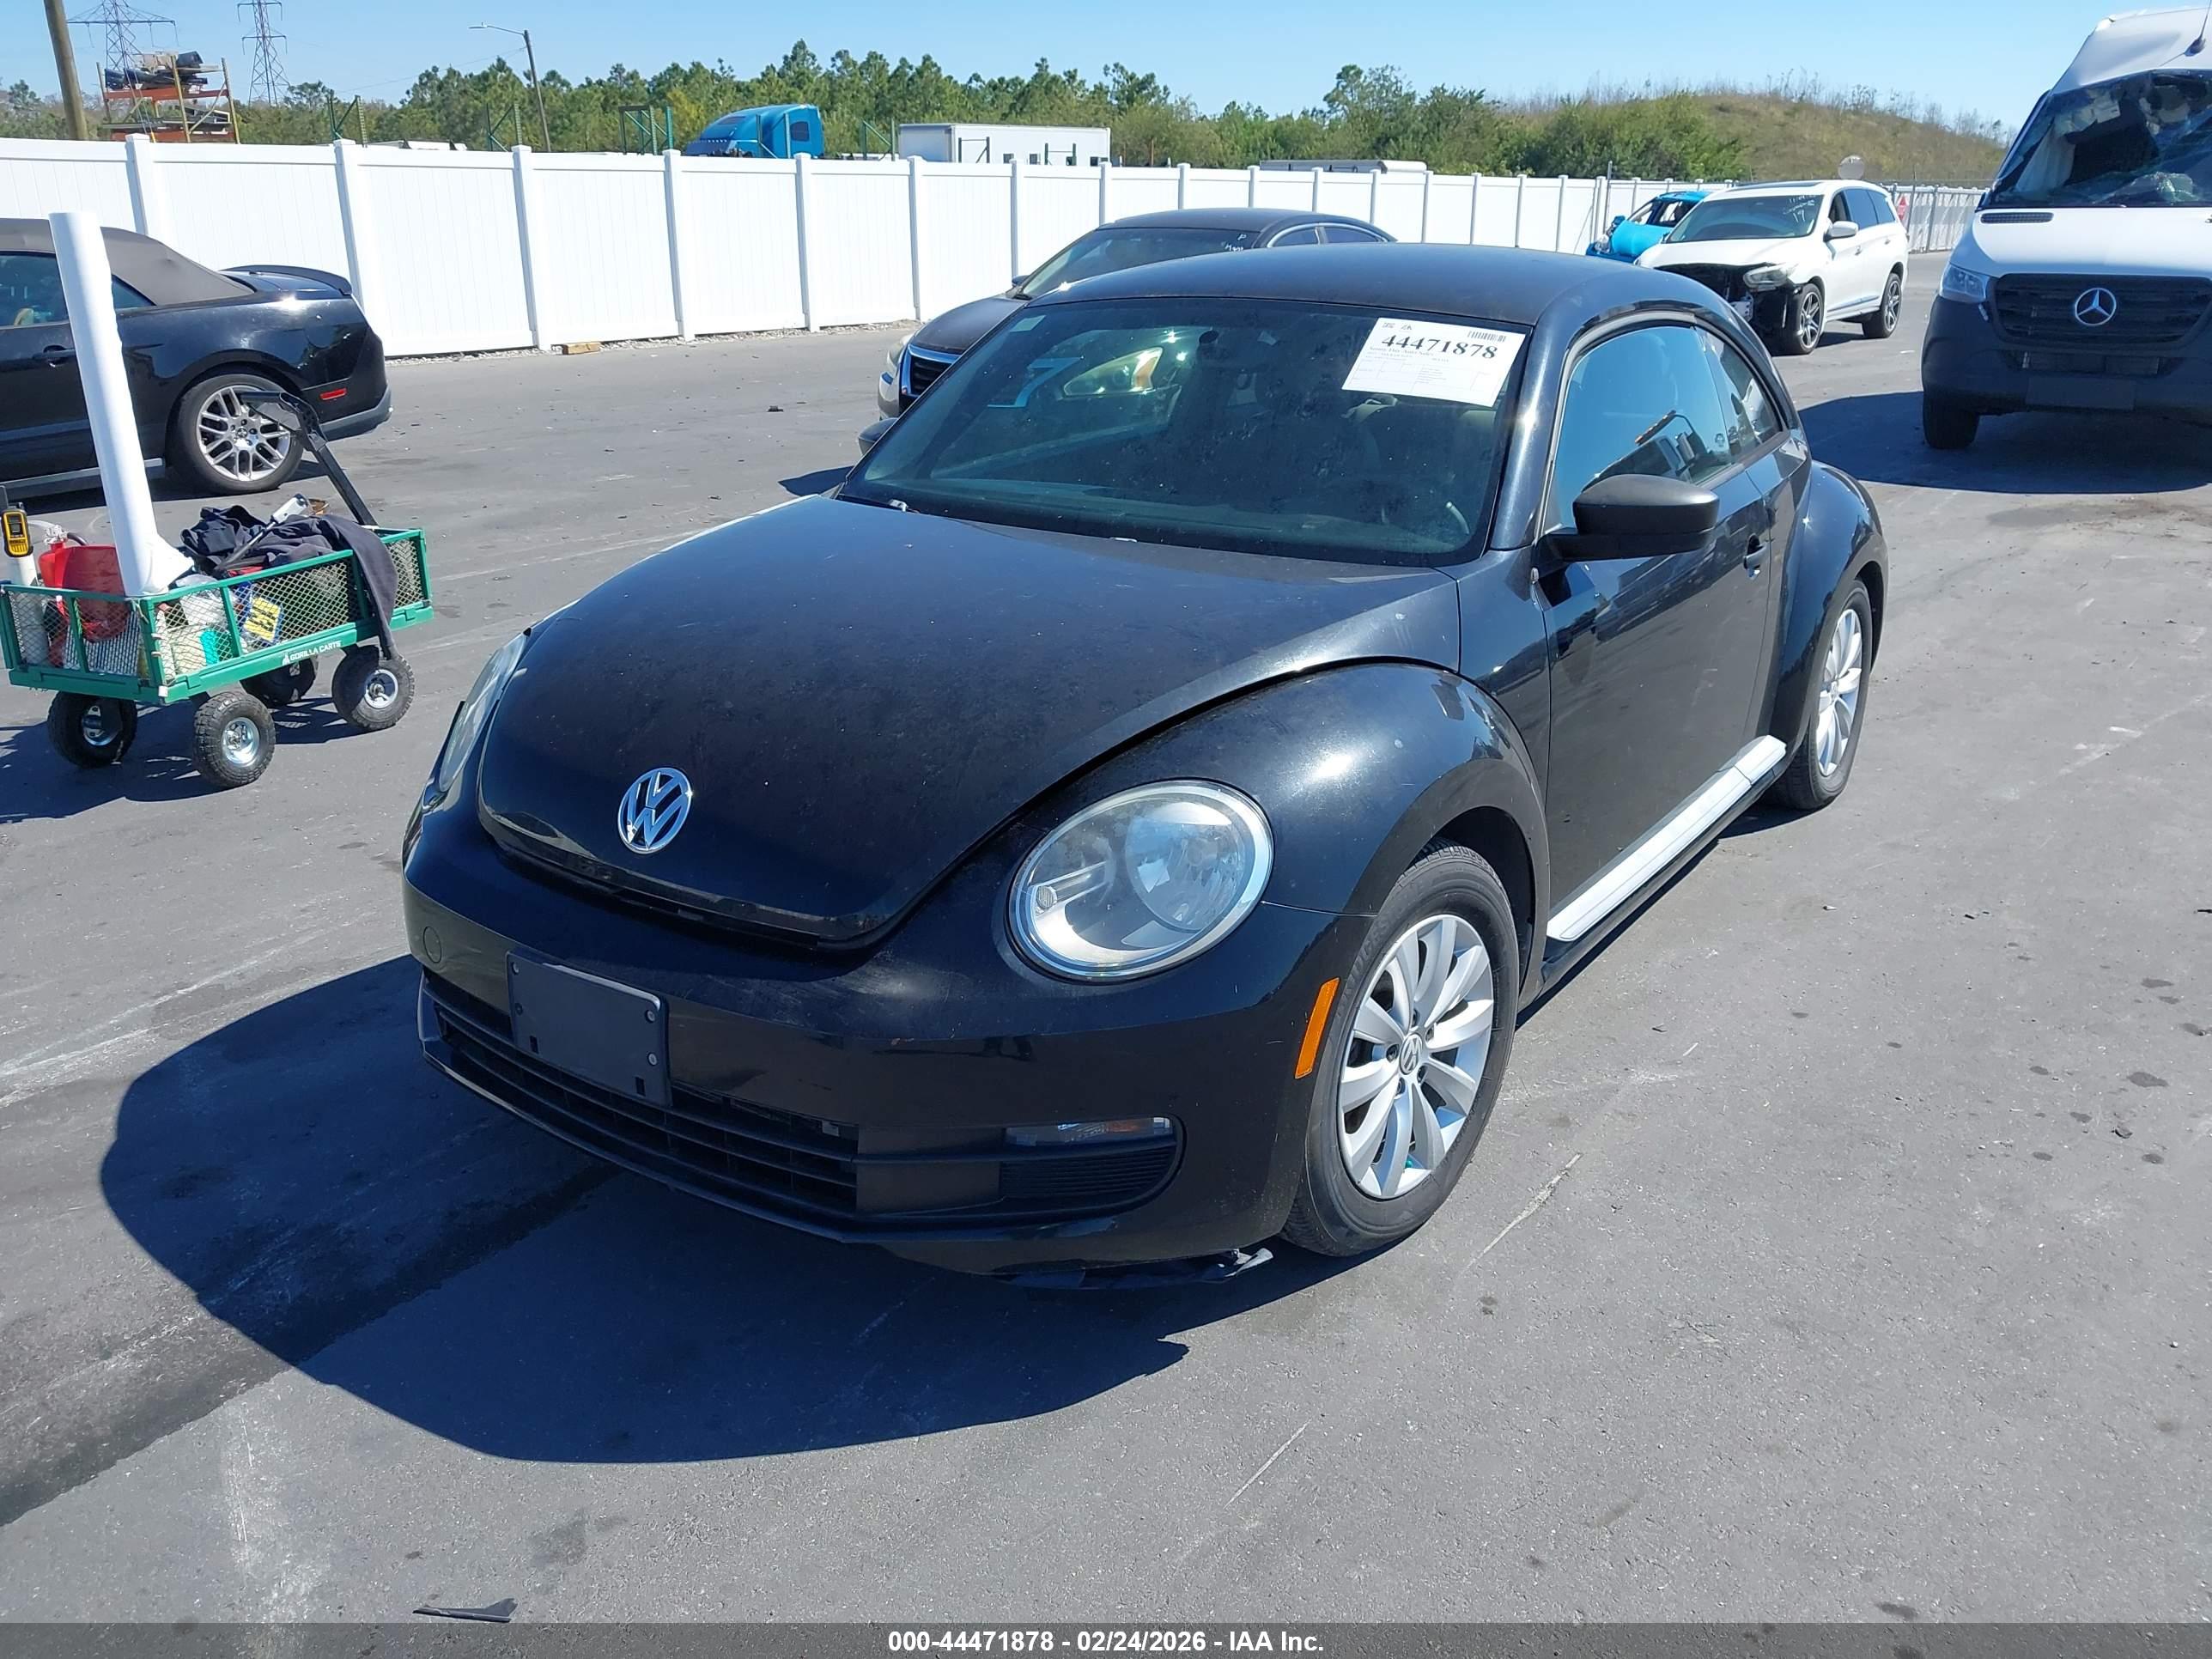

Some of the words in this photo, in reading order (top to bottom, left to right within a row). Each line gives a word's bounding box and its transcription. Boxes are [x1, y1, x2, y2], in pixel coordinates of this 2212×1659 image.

[1381, 334, 1498, 359] 44471878
[289, 648, 319, 661] GORILLA
[319, 641, 342, 653] CARTS
